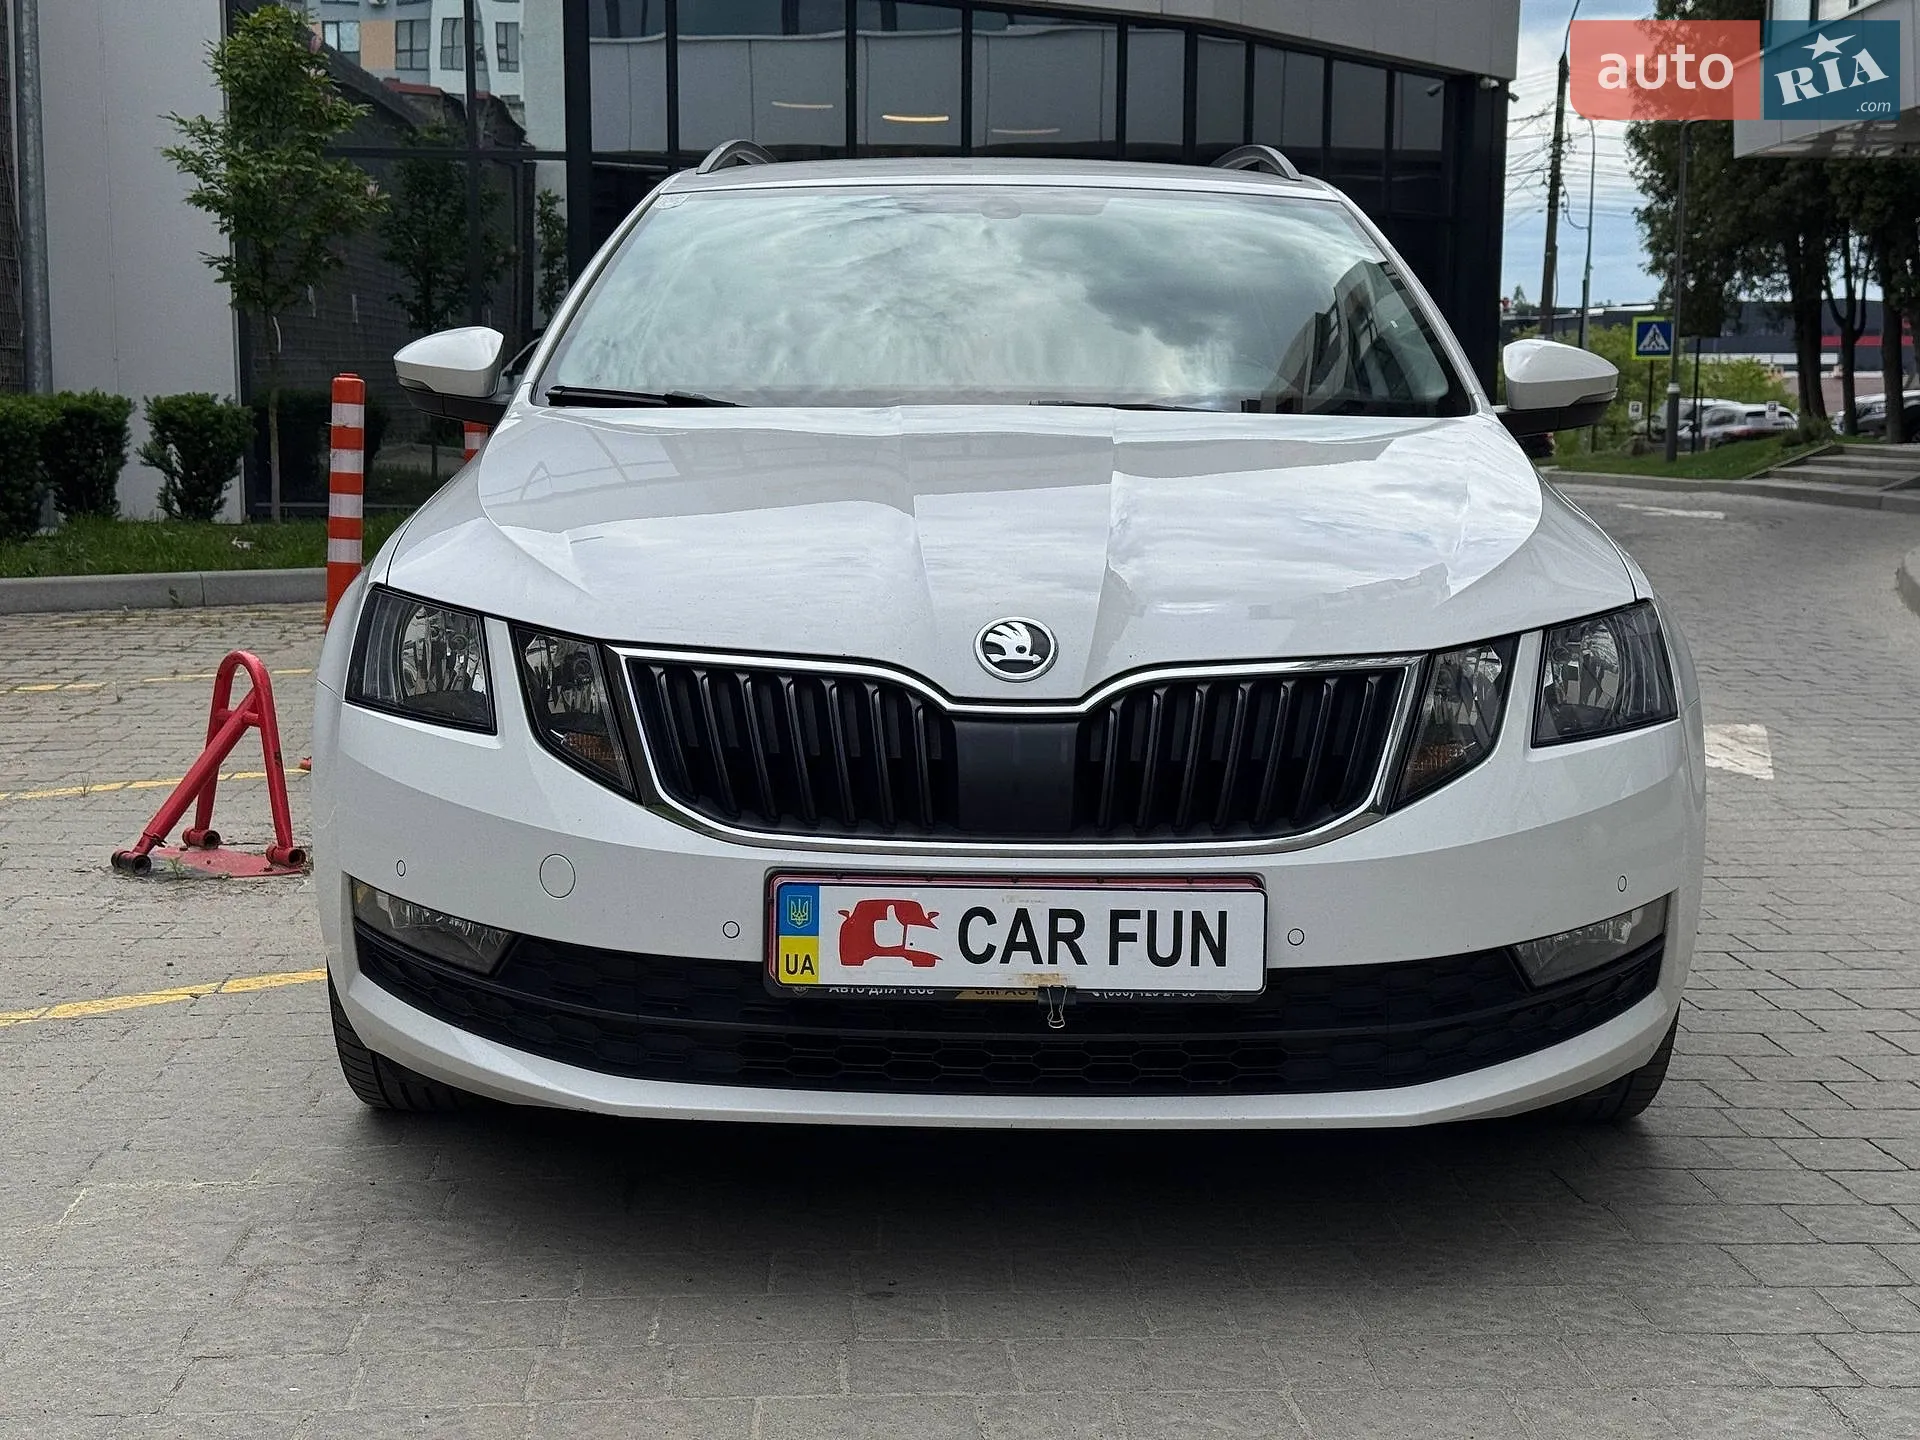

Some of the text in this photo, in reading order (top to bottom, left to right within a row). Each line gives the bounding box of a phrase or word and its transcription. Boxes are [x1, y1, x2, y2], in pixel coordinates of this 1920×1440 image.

[957, 905, 1228, 967] CAR FUN
[785, 954, 816, 976] UA
